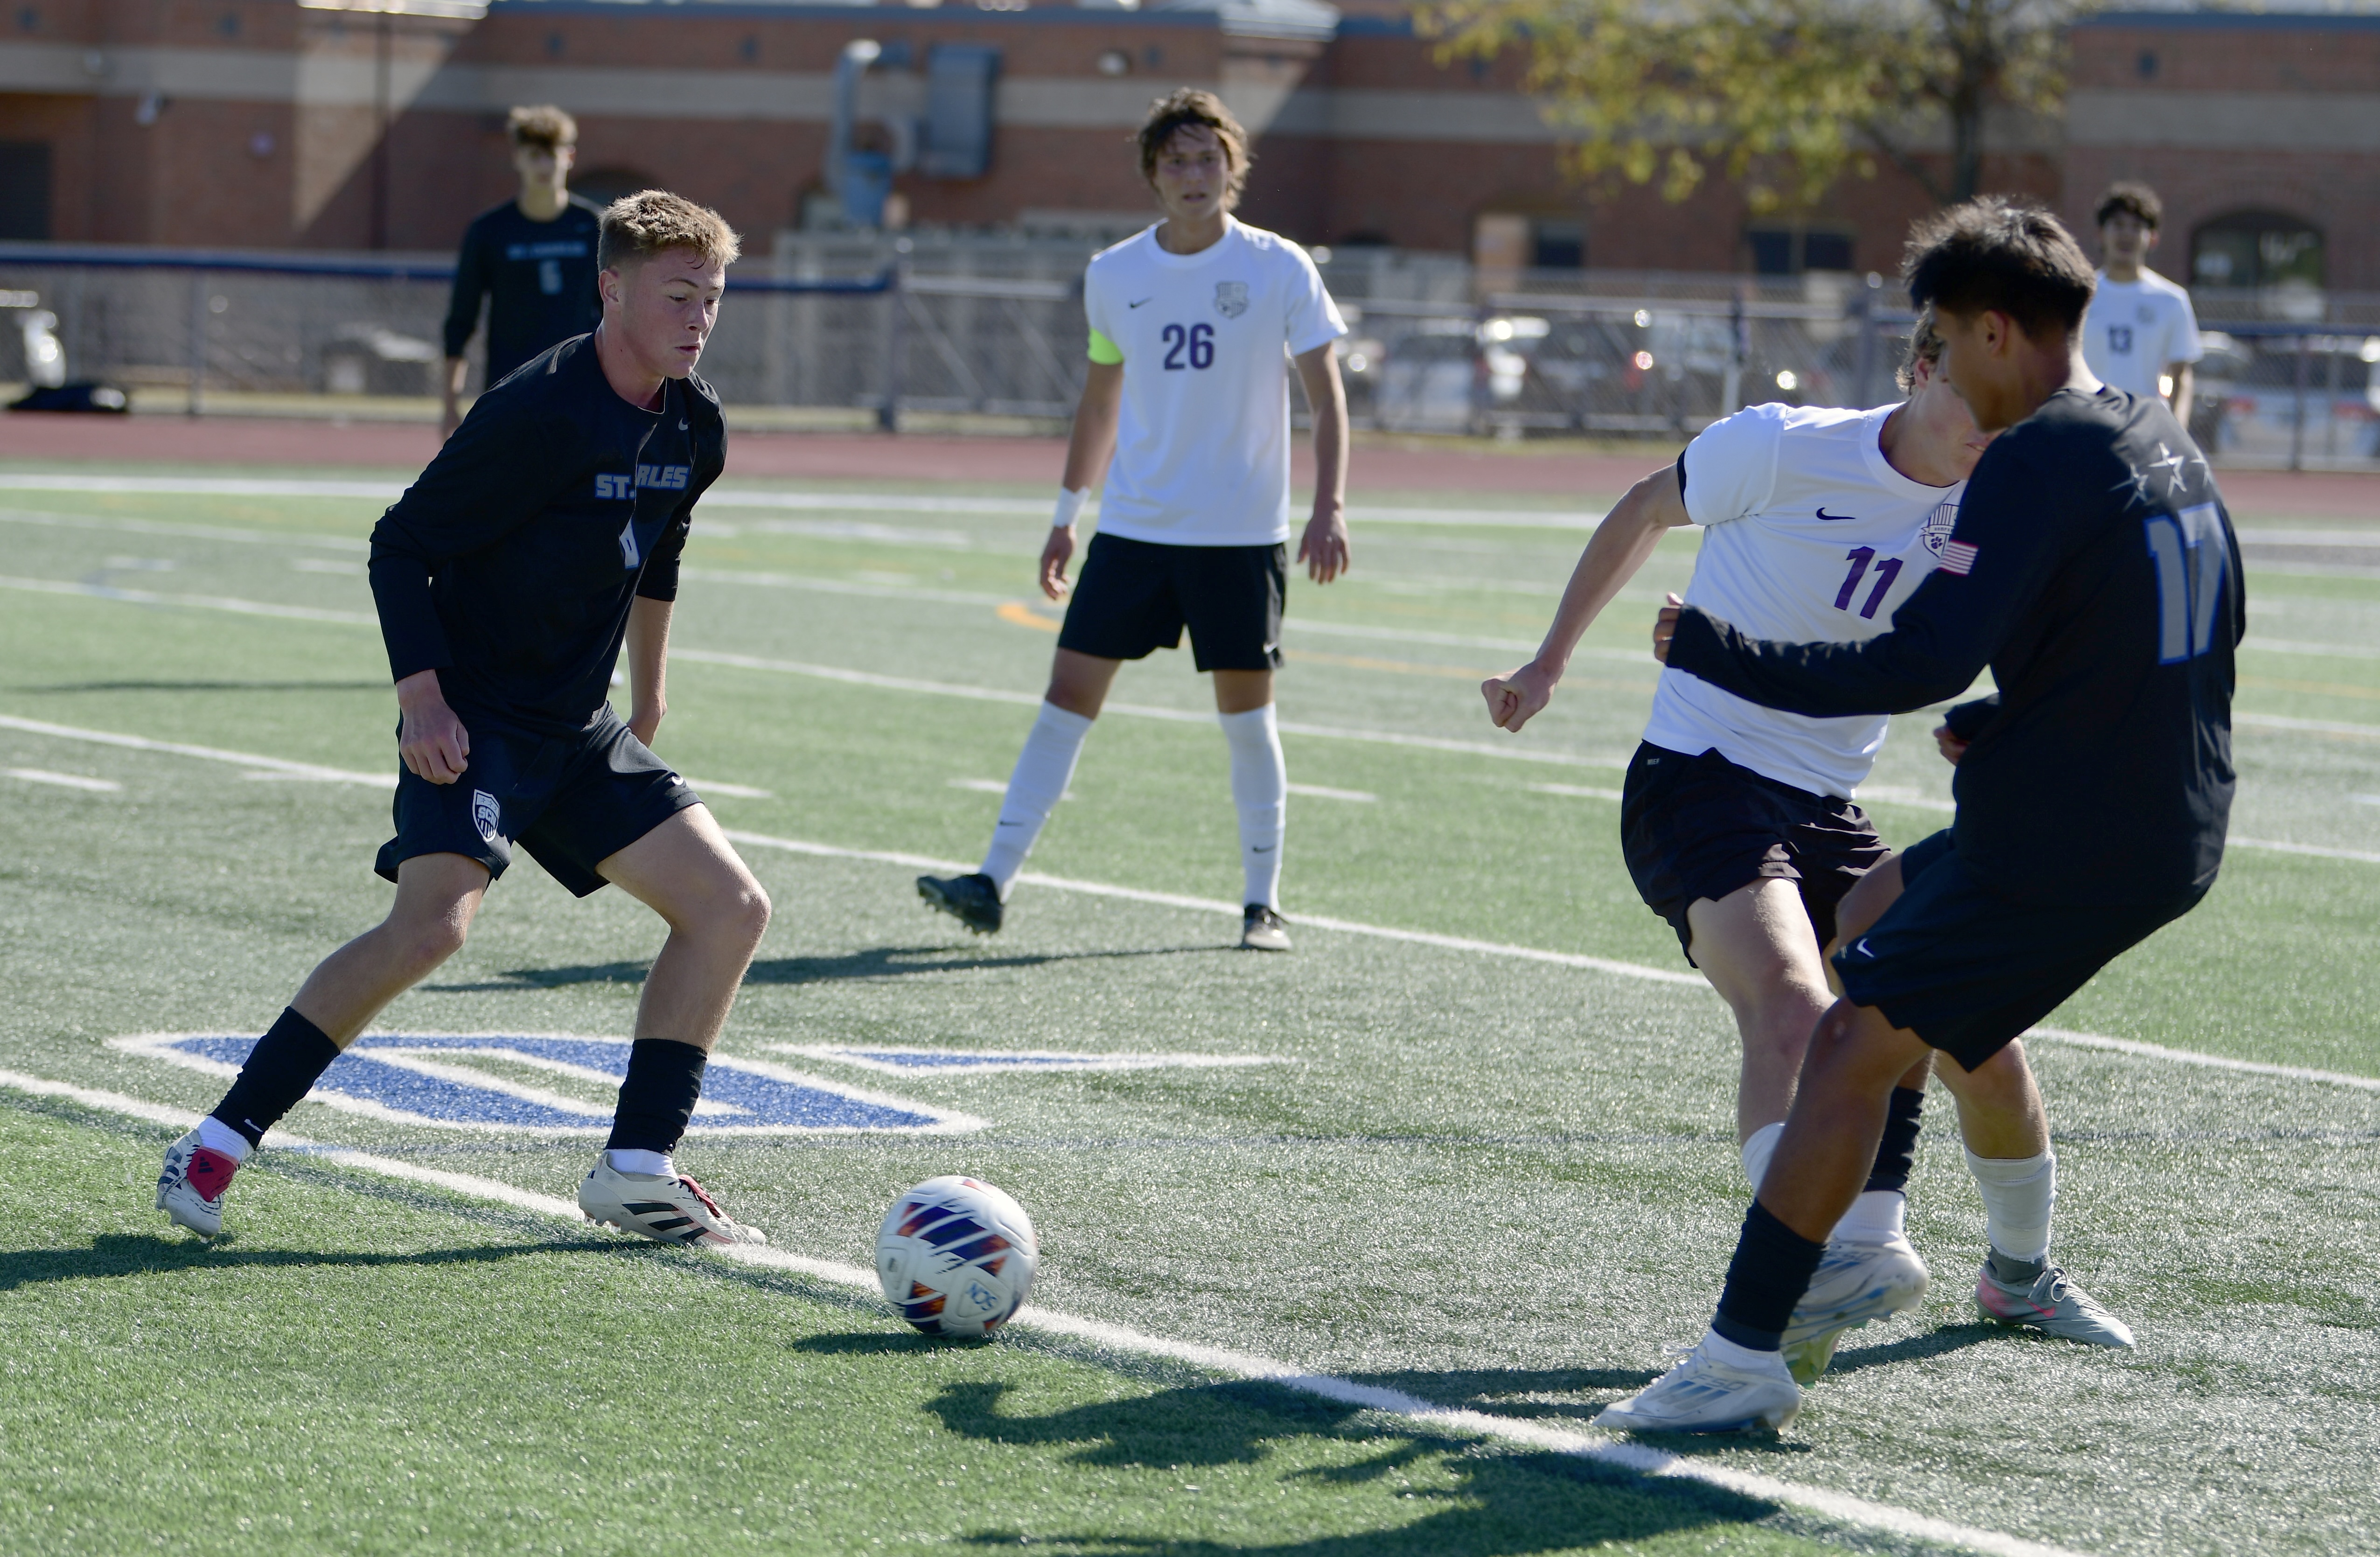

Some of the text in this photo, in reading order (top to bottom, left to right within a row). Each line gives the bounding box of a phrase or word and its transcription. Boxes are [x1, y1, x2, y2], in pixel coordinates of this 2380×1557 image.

[1162, 322, 1215, 370] 26
[594, 465, 691, 499] ST. RLES
[1834, 546, 1904, 620] 11
[2143, 501, 2226, 666] 17
[477, 806, 497, 829] SCN
